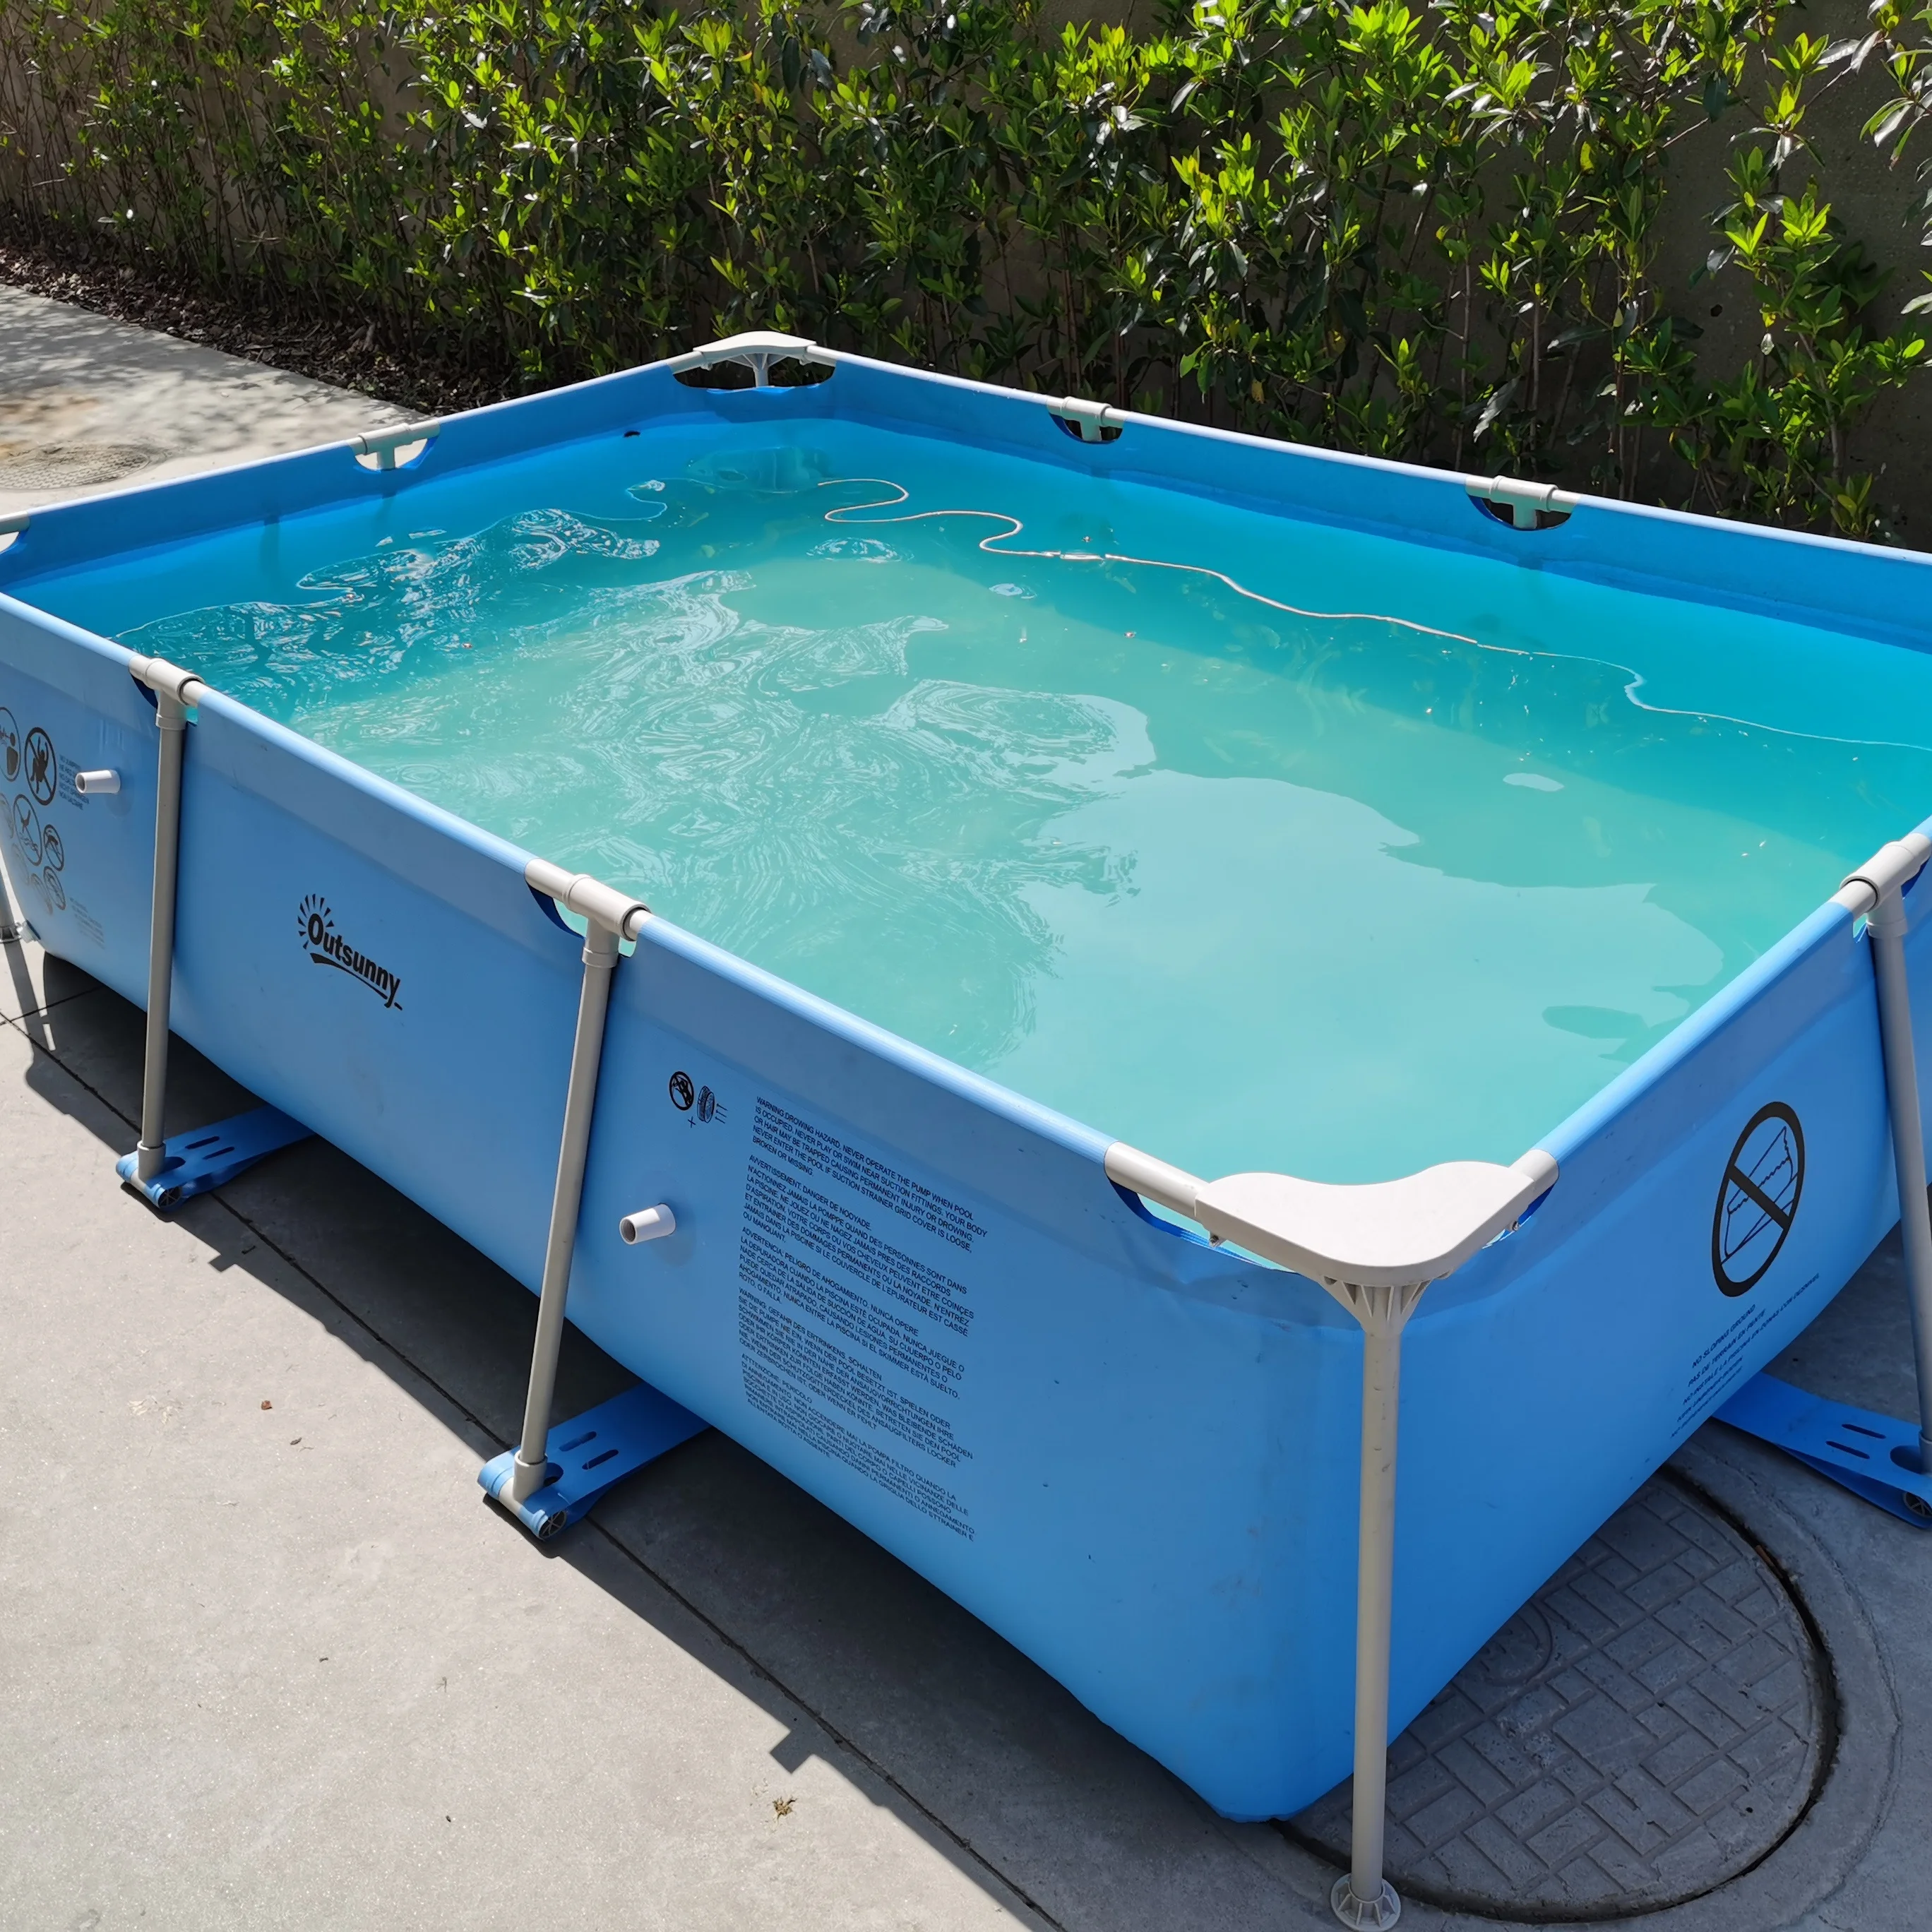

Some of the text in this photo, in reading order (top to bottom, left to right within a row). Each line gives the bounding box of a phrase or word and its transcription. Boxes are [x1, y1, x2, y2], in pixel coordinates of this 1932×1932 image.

[308, 913, 401, 1008] Outsunny
[752, 1135, 777, 1155] BROKEN
[777, 1150, 787, 1161] OR
[752, 1124, 773, 1142] NEVER
[773, 1136, 794, 1154] ENTER
[794, 1148, 807, 1162] THE
[806, 1156, 824, 1171] POOL
[831, 1170, 860, 1191] SUCTION
[861, 1186, 893, 1210] STRAINER
[894, 1205, 912, 1220] GRID
[912, 1215, 936, 1234] COVER
[937, 1228, 945, 1238] IS
[753, 1115, 763, 1126] OR
[763, 1120, 778, 1134] HAIR
[778, 1129, 792, 1141] MAY
[792, 1137, 801, 1147] BE
[801, 1142, 830, 1164] TRAPPED
[830, 1159, 859, 1180] CAUSING
[859, 1175, 900, 1203] PERMANENT
[900, 1198, 925, 1216] INJURY
[925, 1212, 937, 1223] OR
[755, 1105, 762, 1114] IS
[794, 1128, 816, 1145] NEVER
[816, 1140, 833, 1154] PLAY
[832, 1150, 842, 1161] OR
[843, 1155, 861, 1170] SWIM
[861, 1165, 880, 1181] NEAR
[881, 1176, 910, 1198] SUCTION
[945, 1210, 965, 1227] YOUR
[966, 1222, 988, 1237] BODY
[784, 1112, 814, 1134] DROWING
[842, 1144, 865, 1162] NEVER
[865, 1157, 895, 1179] OPERATE
[897, 1174, 910, 1187] THE
[911, 1181, 931, 1197] PUMP
[931, 1193, 953, 1210] WHEN
[953, 1204, 973, 1221] POOL
